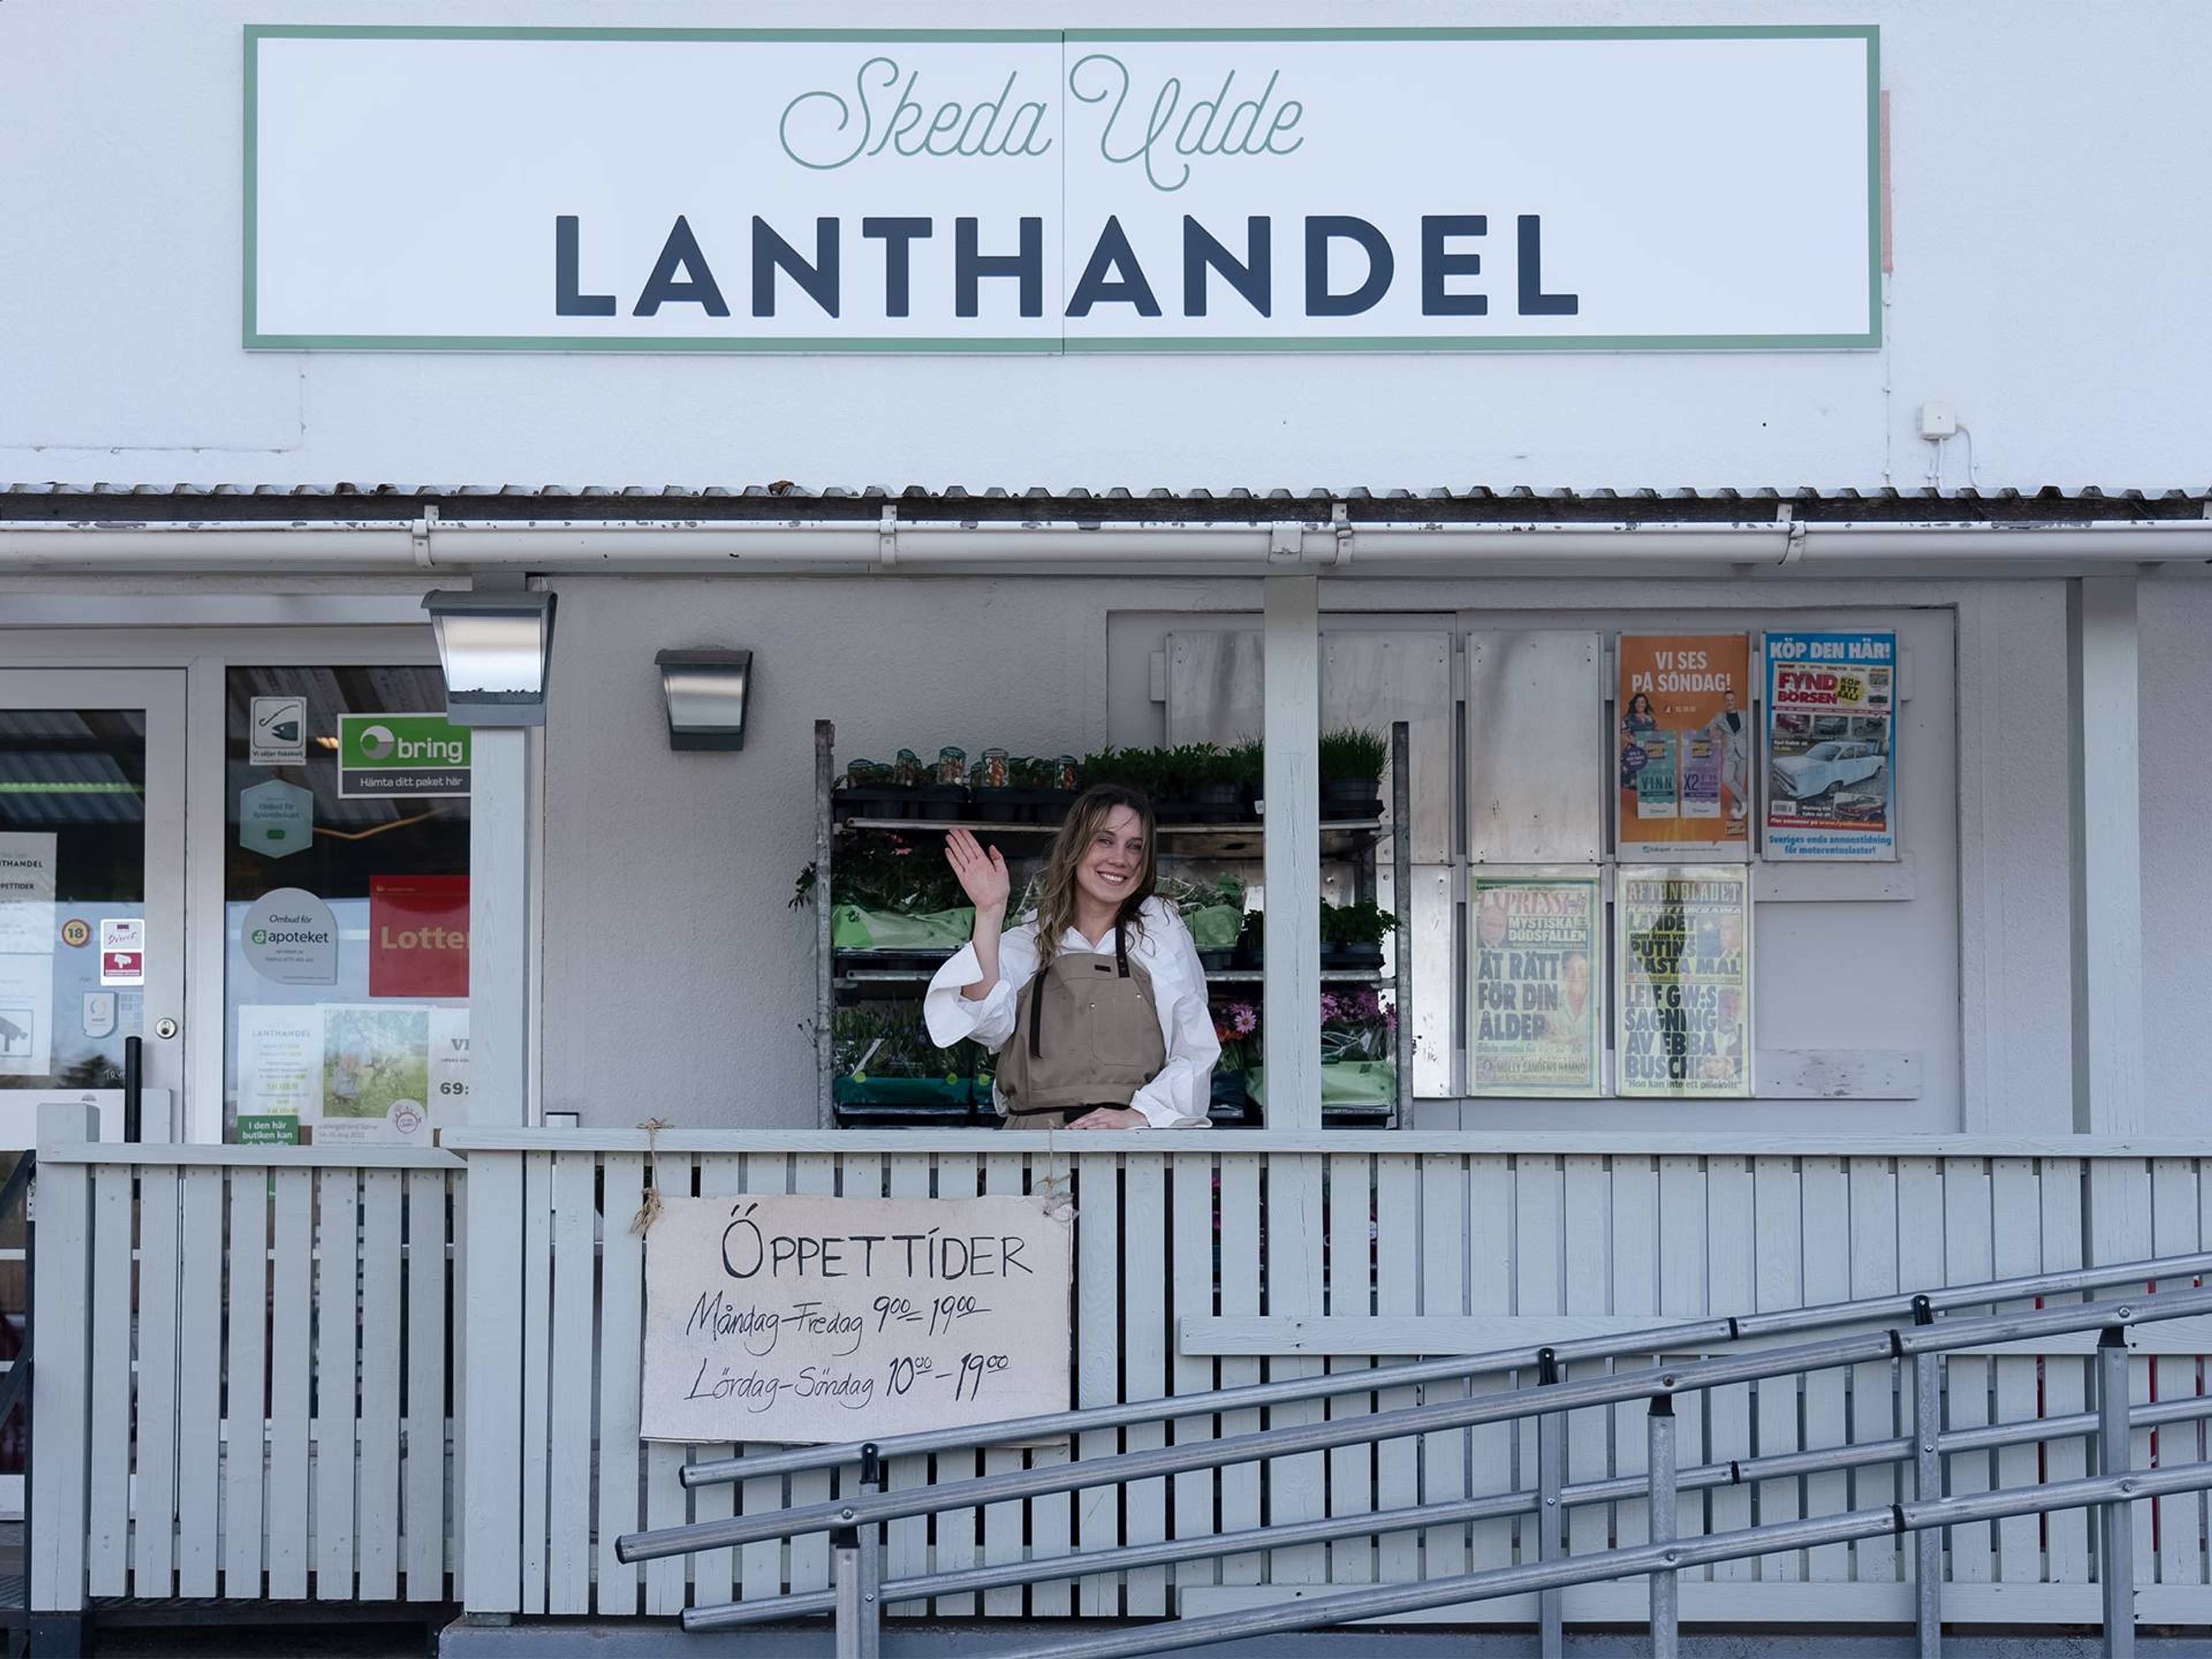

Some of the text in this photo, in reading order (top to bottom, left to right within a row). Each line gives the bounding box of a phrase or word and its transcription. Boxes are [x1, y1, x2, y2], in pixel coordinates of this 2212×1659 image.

[780, 56, 1053, 171] Skeda
[555, 215, 1579, 318] LANTHANDEL
[1770, 637, 1891, 658] KÖP DEN HÄR!
[1655, 652, 1707, 670] VI SES
[1632, 671, 1732, 692] PÅ SÖNDAG!
[1778, 672, 1838, 691] FYND
[1840, 676, 1861, 686] KÖP
[1778, 689, 1837, 704] BÖRSEN
[397, 737, 463, 763] bring
[360, 777, 463, 787] Hämta ditt paket här
[1642, 776, 1673, 789] VINN
[1770, 835, 1892, 846] Sveriges enda annonstidning
[1785, 846, 1797, 854] för
[269, 914, 312, 923] Ombud för
[1509, 916, 1573, 929] MYSTISKA
[67, 927, 84, 938] 18
[268, 931, 328, 945] apoteket
[1629, 940, 1696, 957] PUTINS
[1478, 950, 1560, 980] ÄT RÄTT
[1478, 980, 1558, 1010] FÖR DIN
[1625, 985, 1717, 1008] LEIF GW:S
[1626, 1032, 1717, 1055] AV EBBA
[1648, 1080, 1665, 1088] kan
[1666, 1080, 1683, 1089] inte
[243, 1130, 293, 1139] butiken kan
